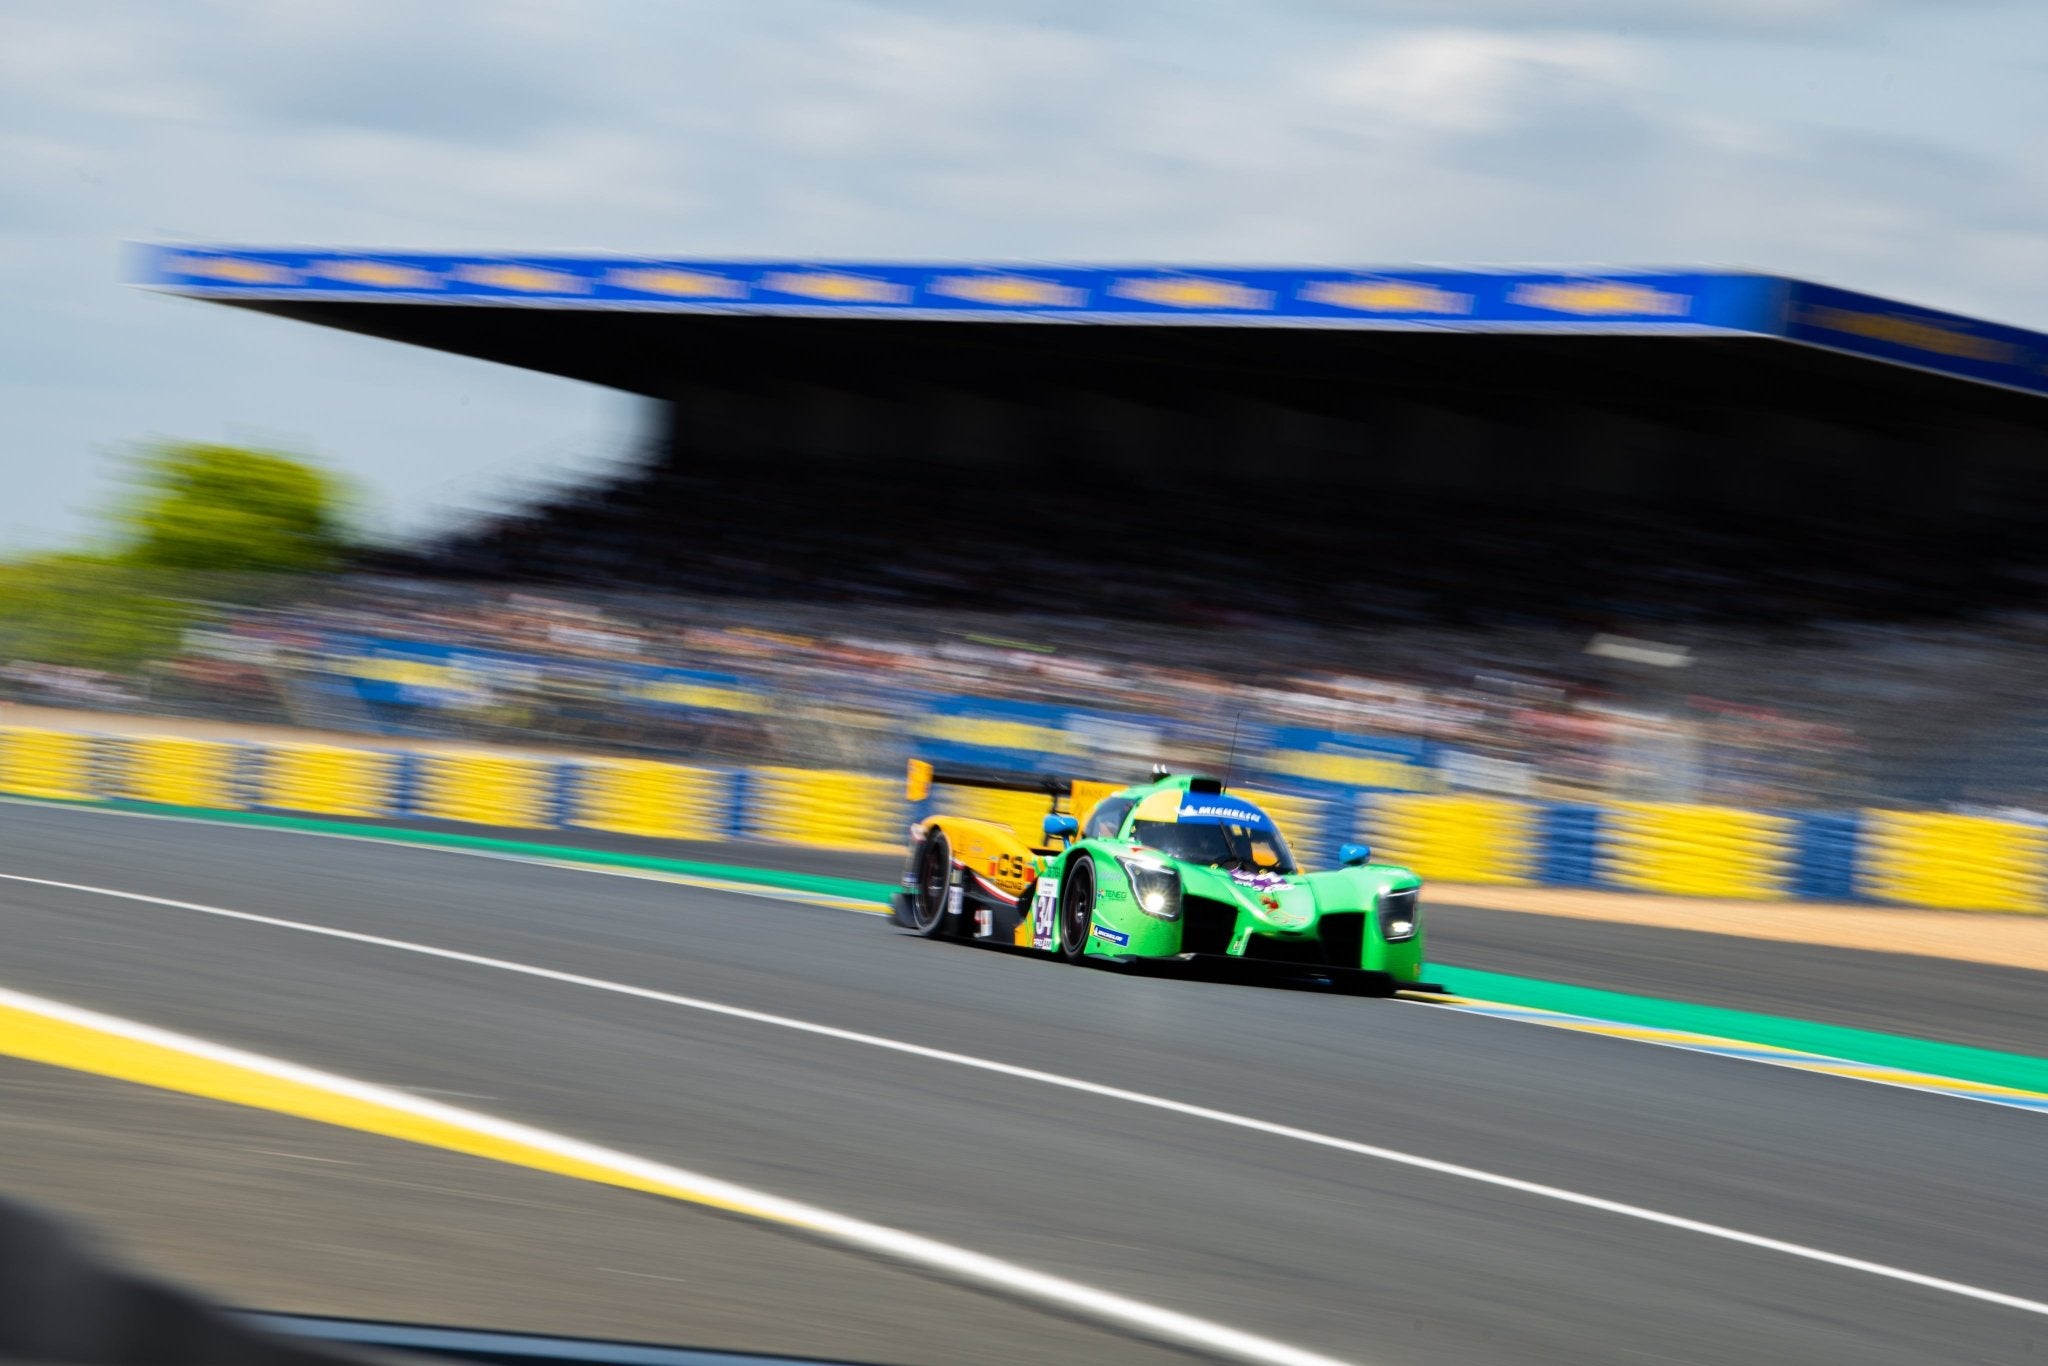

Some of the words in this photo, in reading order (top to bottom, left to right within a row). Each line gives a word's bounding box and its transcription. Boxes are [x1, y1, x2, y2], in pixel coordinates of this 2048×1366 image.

[1198, 806, 1262, 823] MICHELIN
[1000, 853, 1023, 879] CS
[995, 878, 1023, 891] RACING
[1035, 896, 1055, 936] 34
[1097, 930, 1124, 942] MICHELIN
